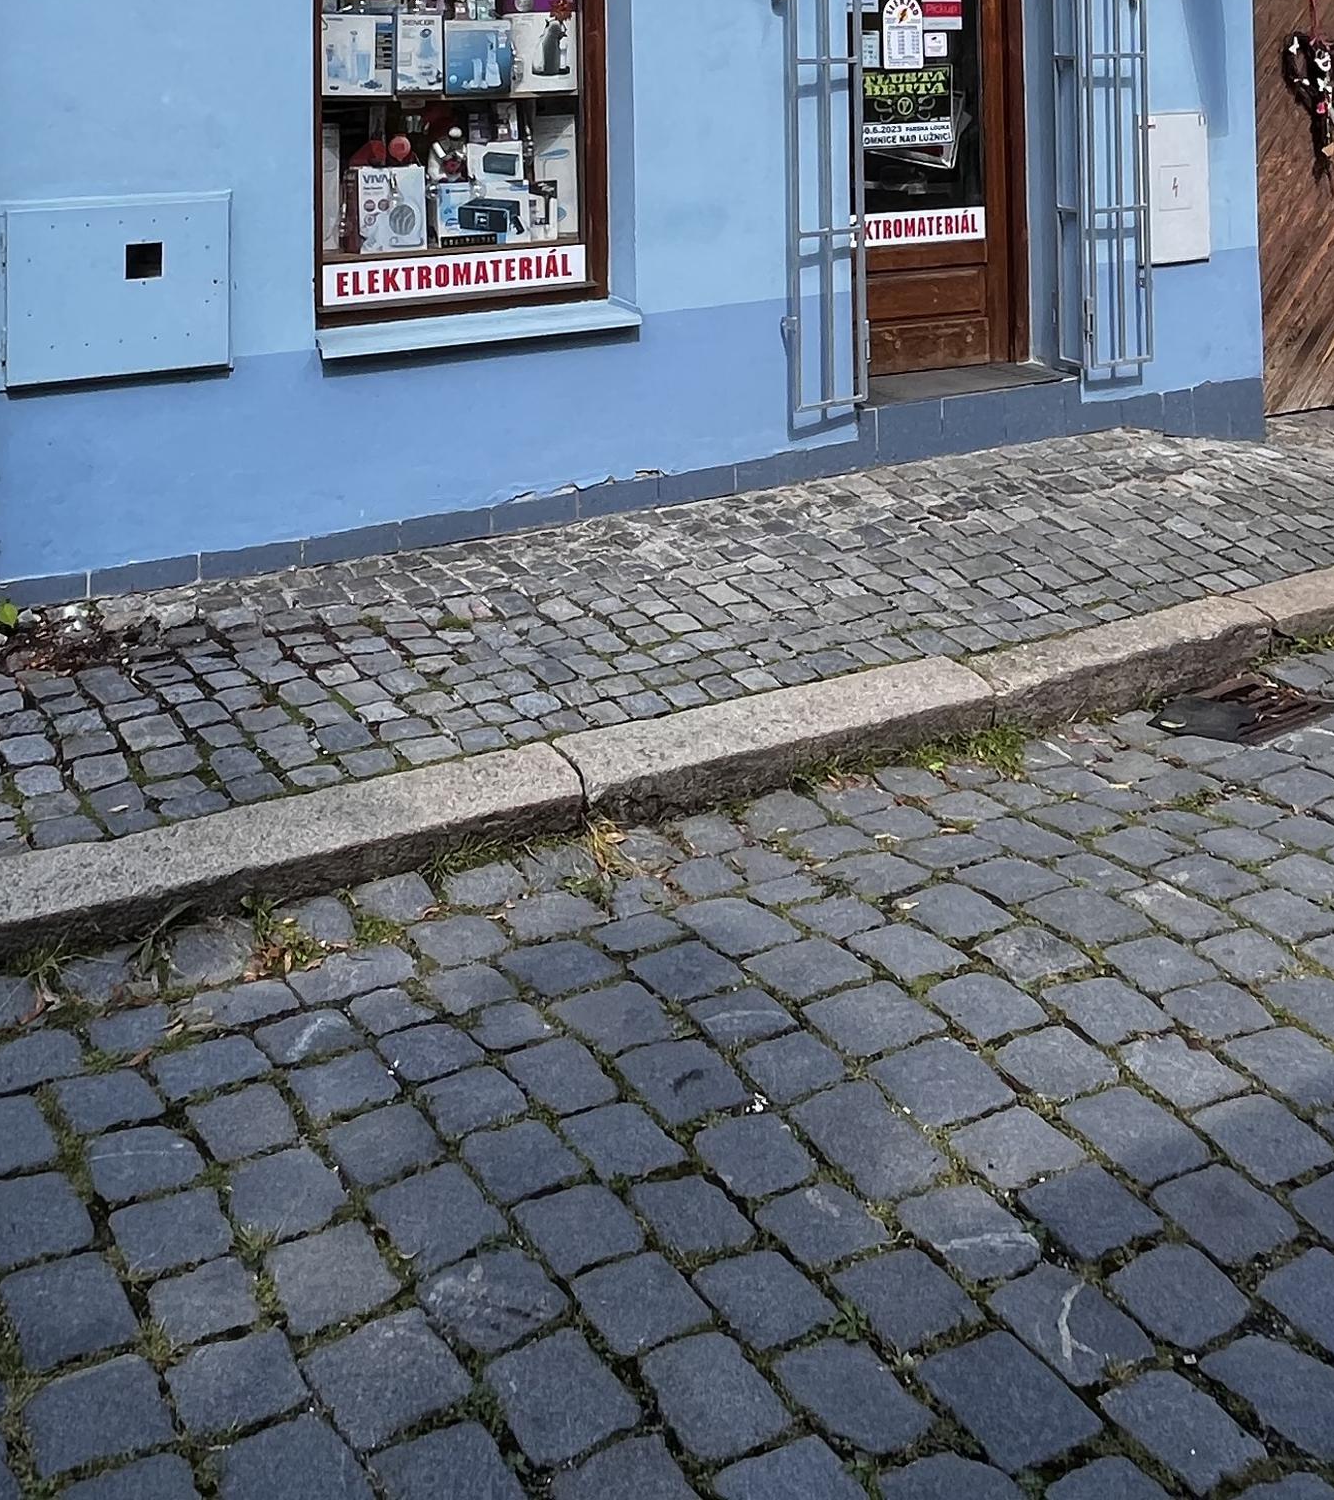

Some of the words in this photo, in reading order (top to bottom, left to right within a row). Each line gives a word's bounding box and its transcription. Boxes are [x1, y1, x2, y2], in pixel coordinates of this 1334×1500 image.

[863, 125, 902, 135] 0.6.2023
[864, 136, 897, 145] OMNICE
[899, 134, 917, 144] NAD
[362, 173, 393, 184] VIVA
[859, 209, 979, 242] KTROMATERIÁL
[336, 248, 572, 297] ELEKTROMATERIÁL
